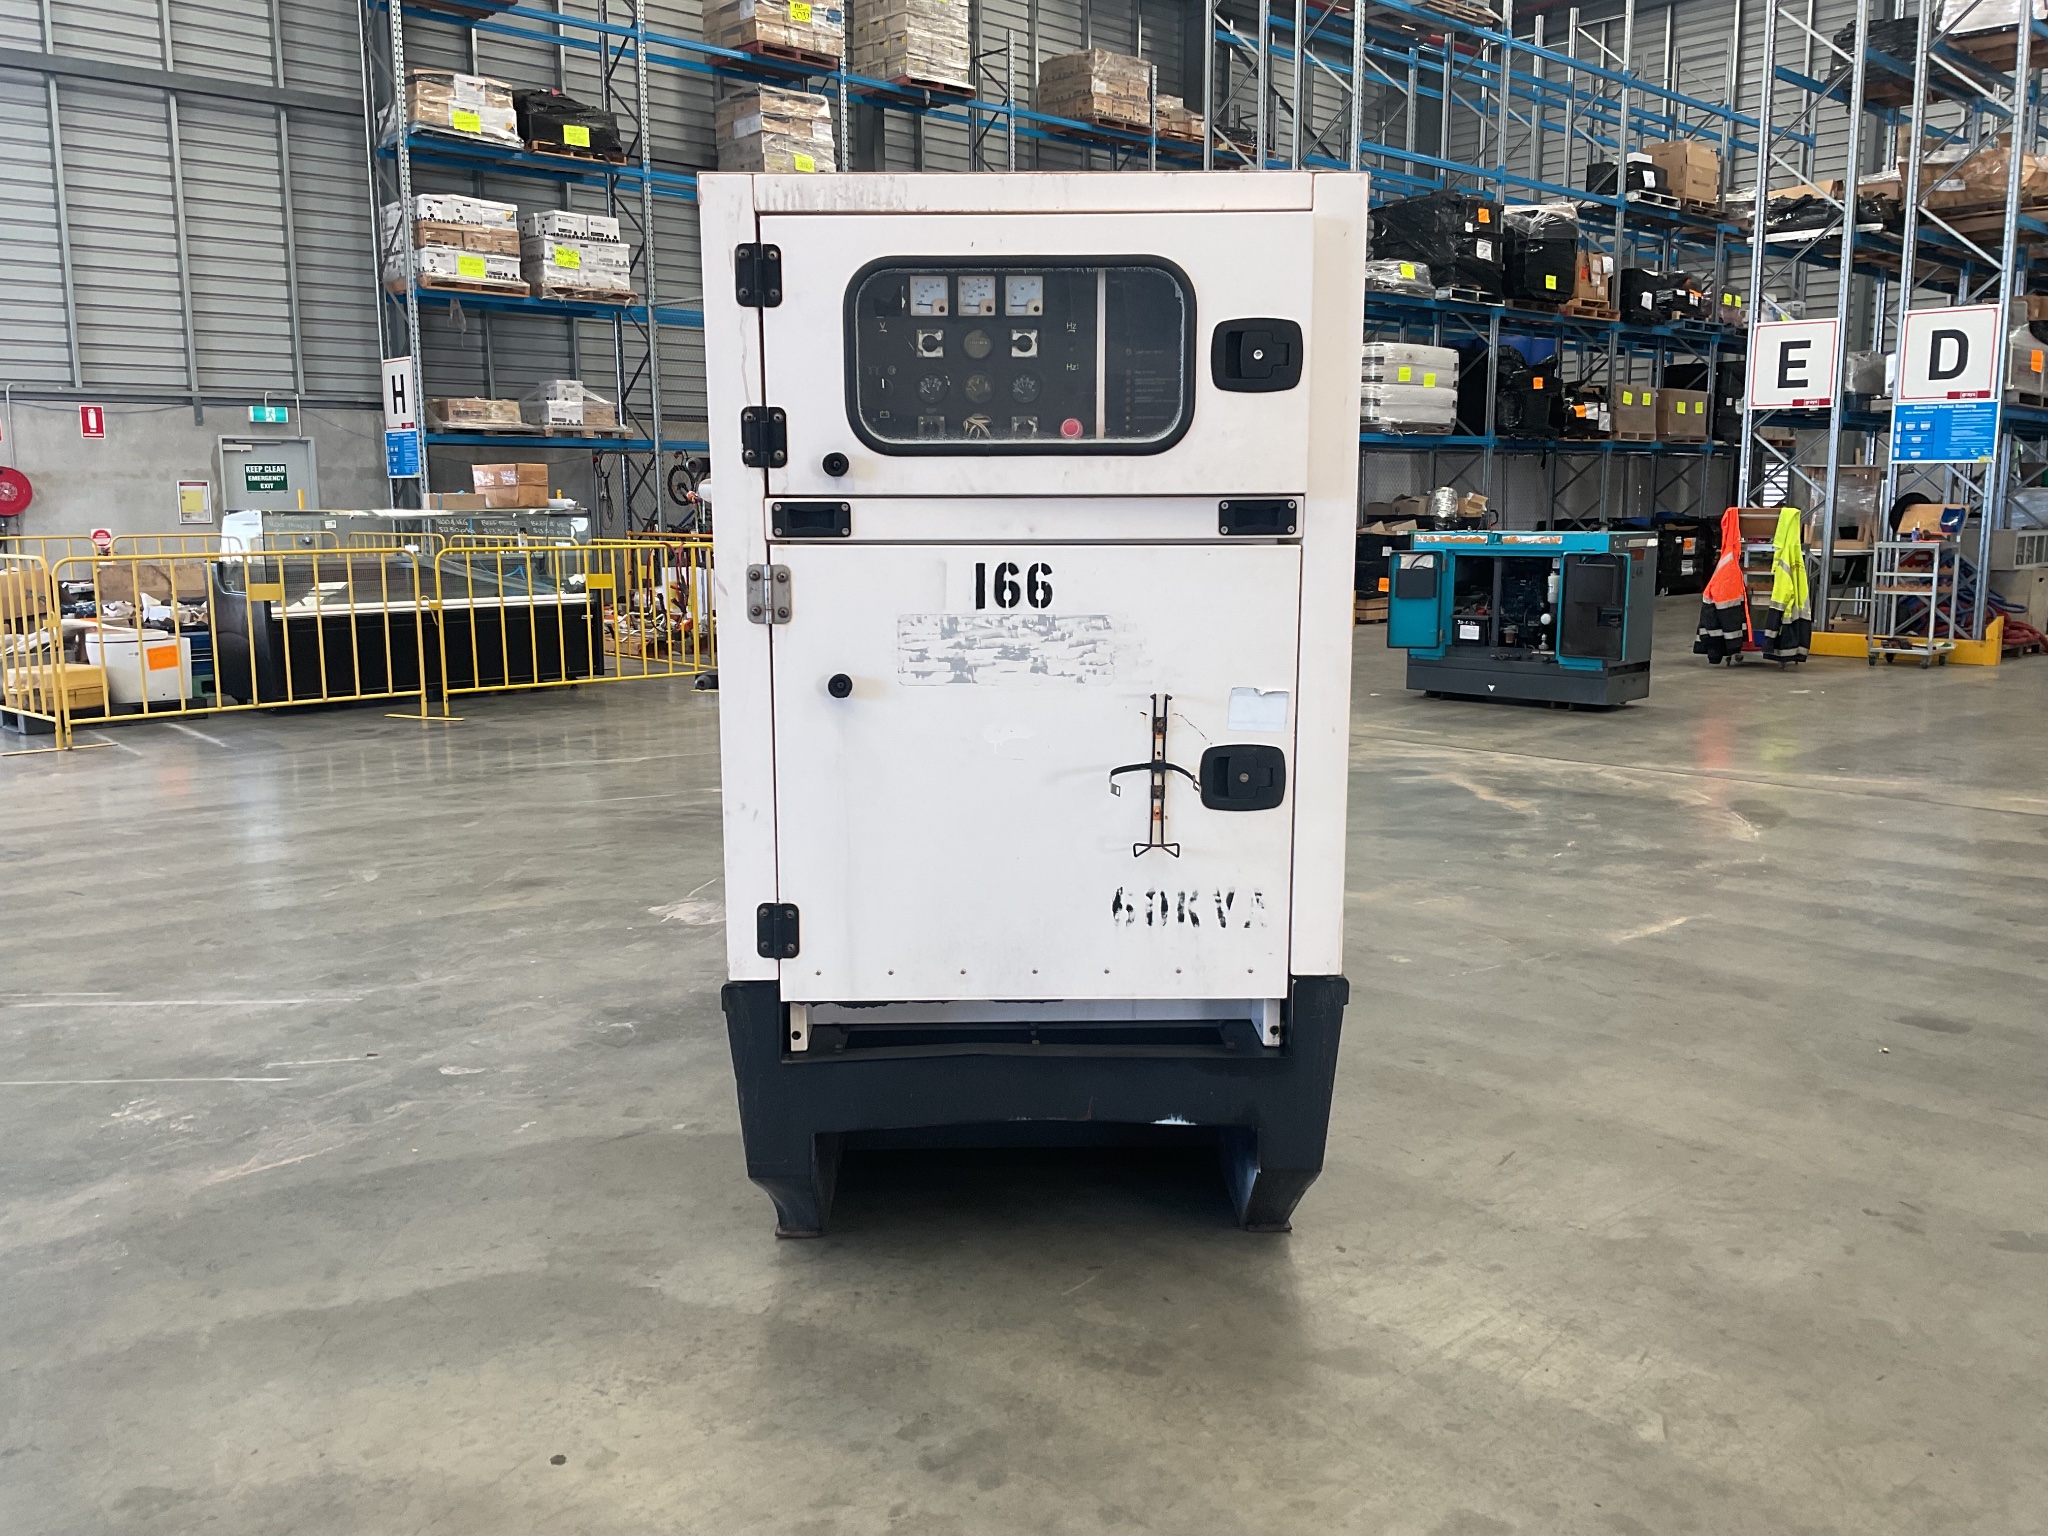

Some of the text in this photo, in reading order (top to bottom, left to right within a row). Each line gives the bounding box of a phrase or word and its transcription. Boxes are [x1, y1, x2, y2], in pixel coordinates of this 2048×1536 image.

[1066, 321, 1077, 330] Hz
[1777, 340, 1811, 389] E
[1928, 329, 1969, 381] D
[392, 374, 406, 415] H
[246, 465, 286, 473] KEEP CLEAR
[976, 562, 1053, 610] 166
